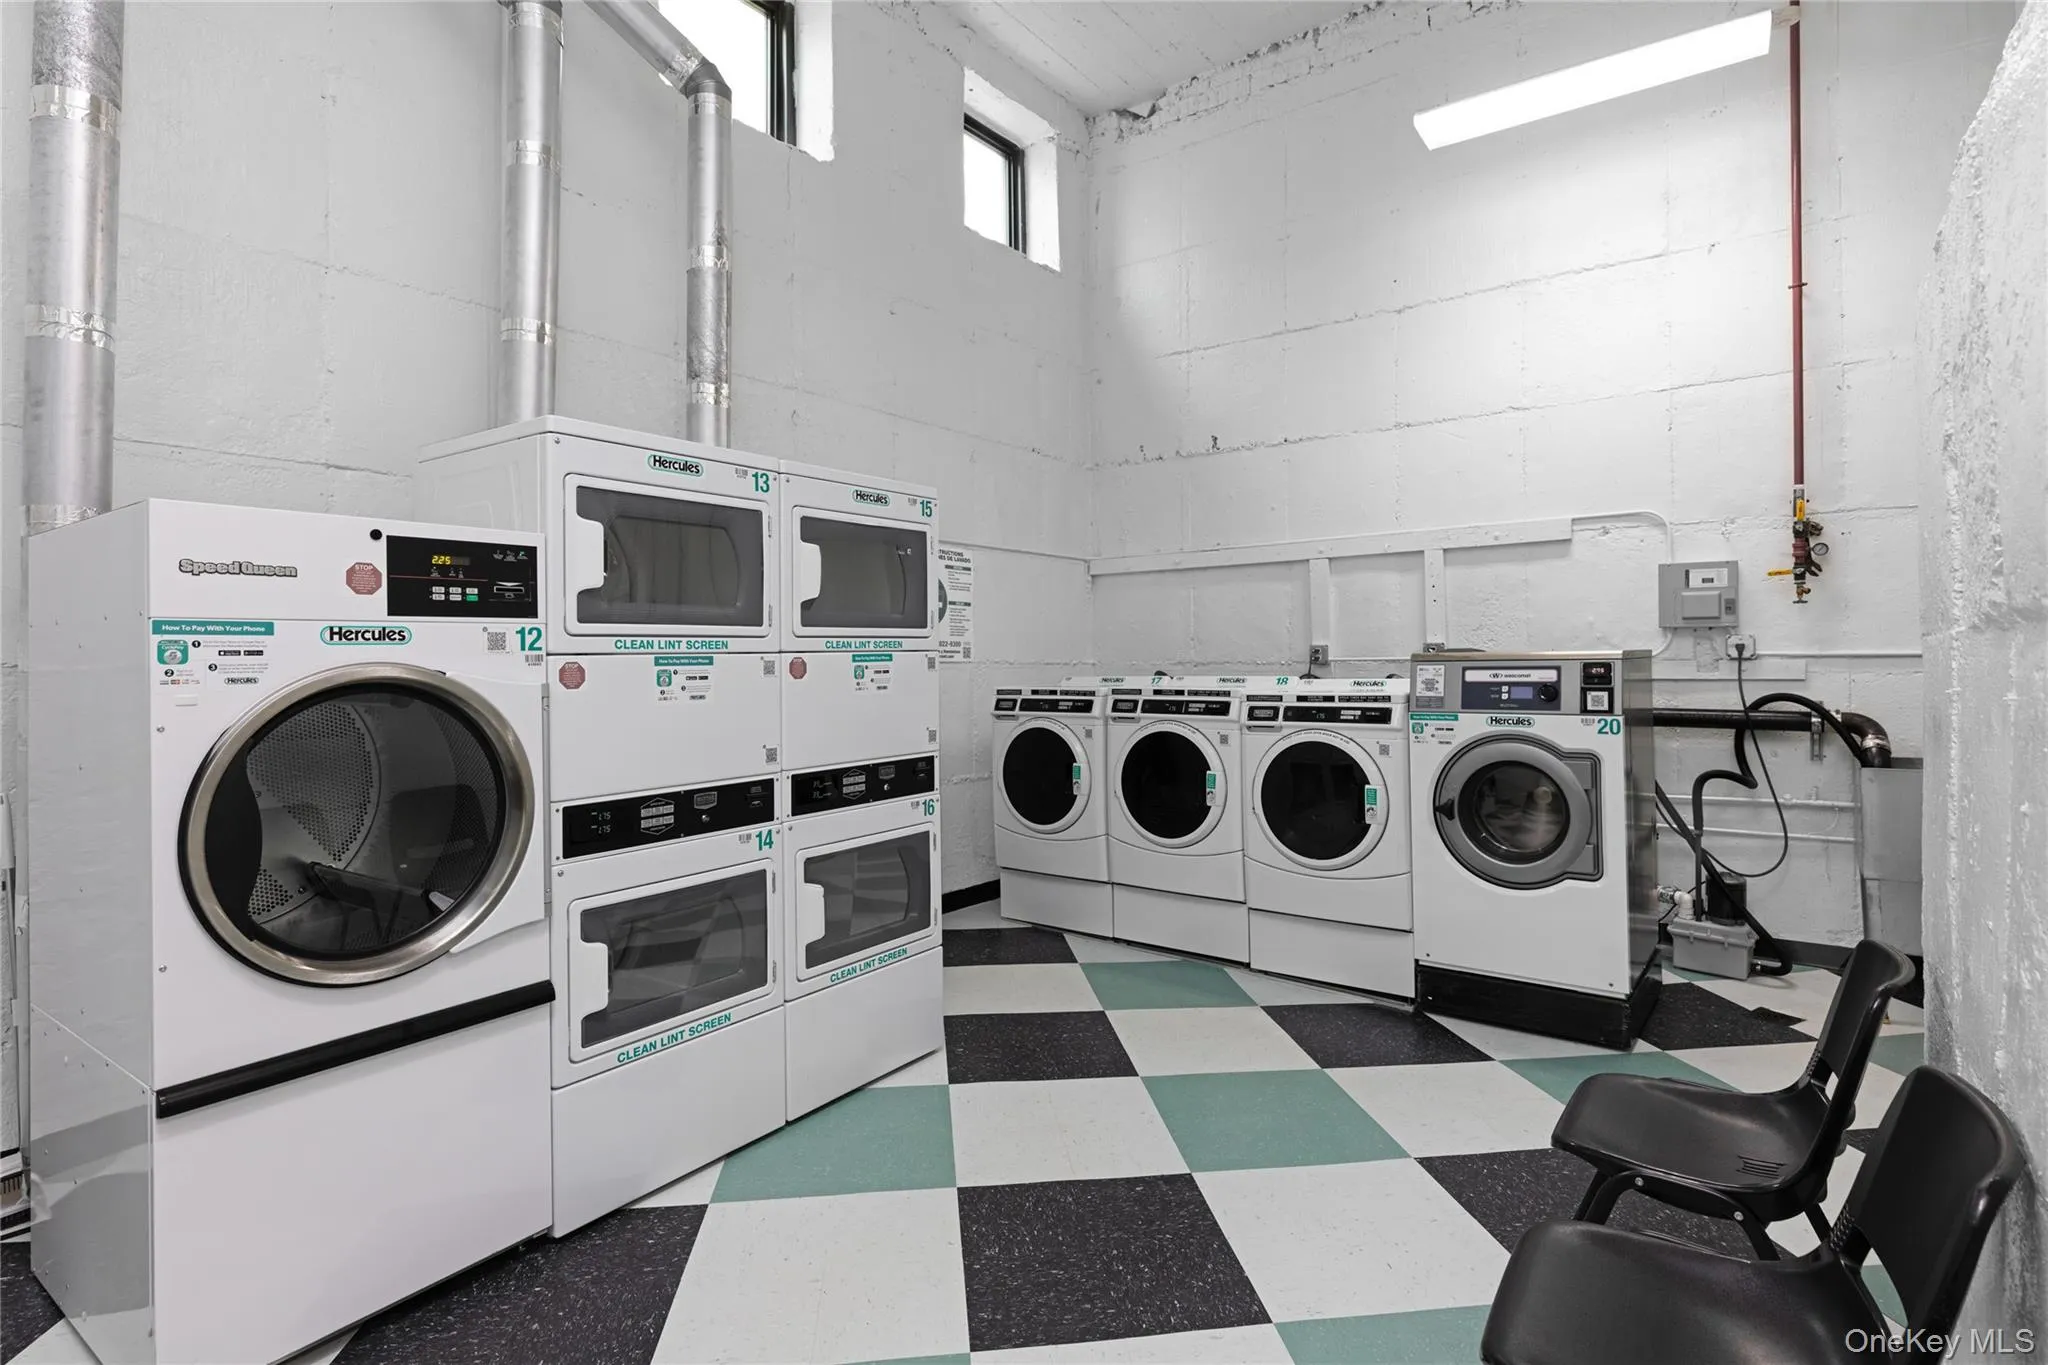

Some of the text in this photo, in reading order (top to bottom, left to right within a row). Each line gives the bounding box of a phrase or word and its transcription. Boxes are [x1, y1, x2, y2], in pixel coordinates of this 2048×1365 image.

[653, 455, 700, 474] Hercules
[752, 471, 770, 493] 13
[855, 490, 888, 504] Hercules
[920, 500, 932, 518] 15
[179, 559, 298, 578] Speed Queen
[329, 626, 406, 642] Hercules
[515, 626, 543, 652] 12
[614, 640, 728, 650] CLEAN LINT SCREEN
[825, 640, 852, 648] CLEAN
[873, 640, 903, 648] SCREEN
[1276, 677, 1288, 685] 18
[1490, 717, 1532, 726] Hercules
[1597, 718, 1621, 735] 20
[922, 799, 935, 816] 16
[756, 830, 774, 851] 14
[830, 948, 907, 982] CLEAN LINT SCREEN
[617, 1012, 731, 1063] CLEAN LINT SCREEN
